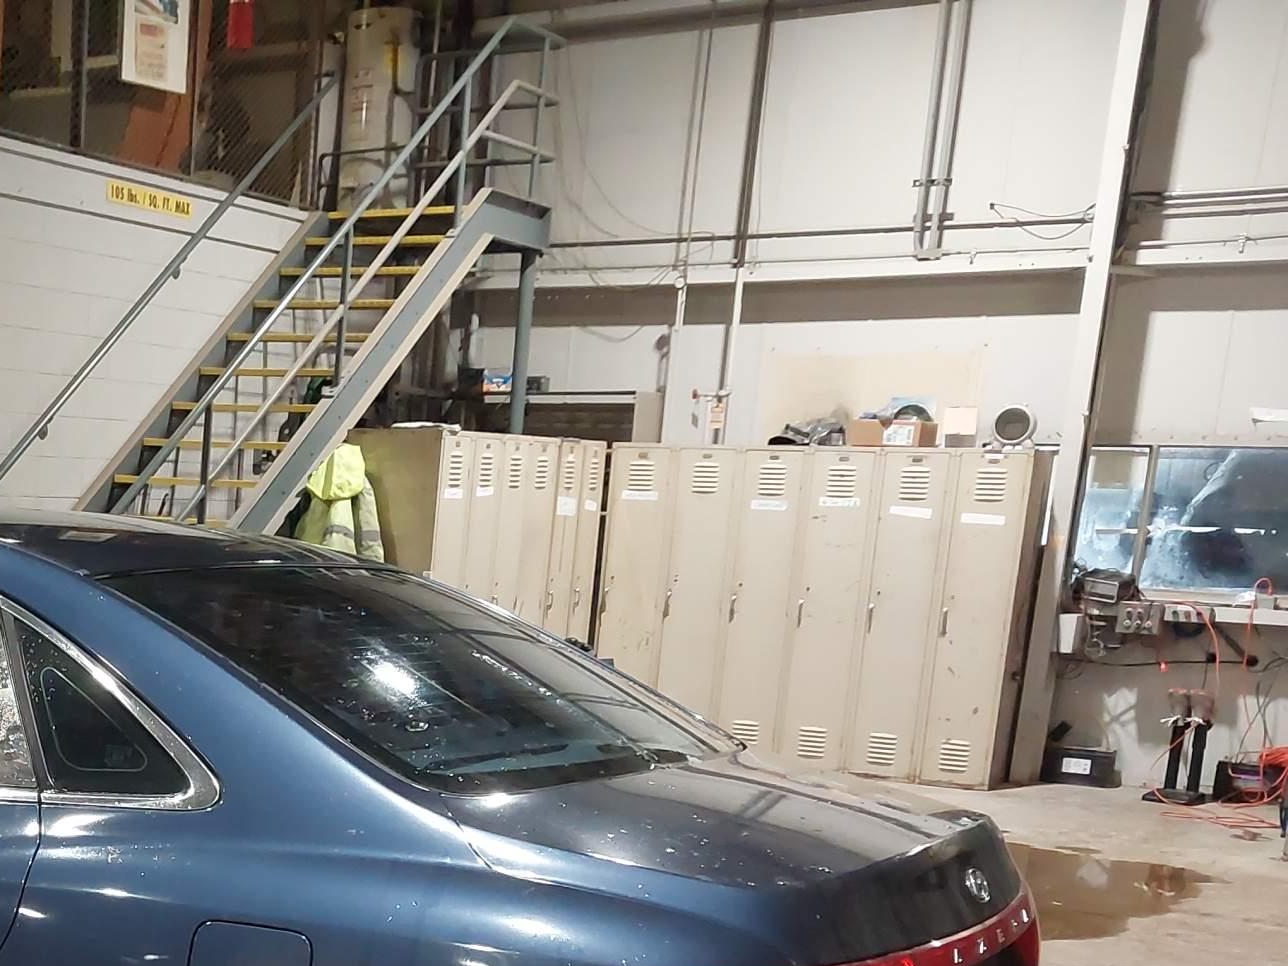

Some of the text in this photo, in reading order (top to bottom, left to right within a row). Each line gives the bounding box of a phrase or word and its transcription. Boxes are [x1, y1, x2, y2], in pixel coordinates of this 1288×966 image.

[111, 184, 125, 201] 105
[127, 188, 140, 204] lbs.
[148, 193, 160, 209] SQ.
[162, 196, 173, 212] FT.
[175, 200, 191, 215] MAX
